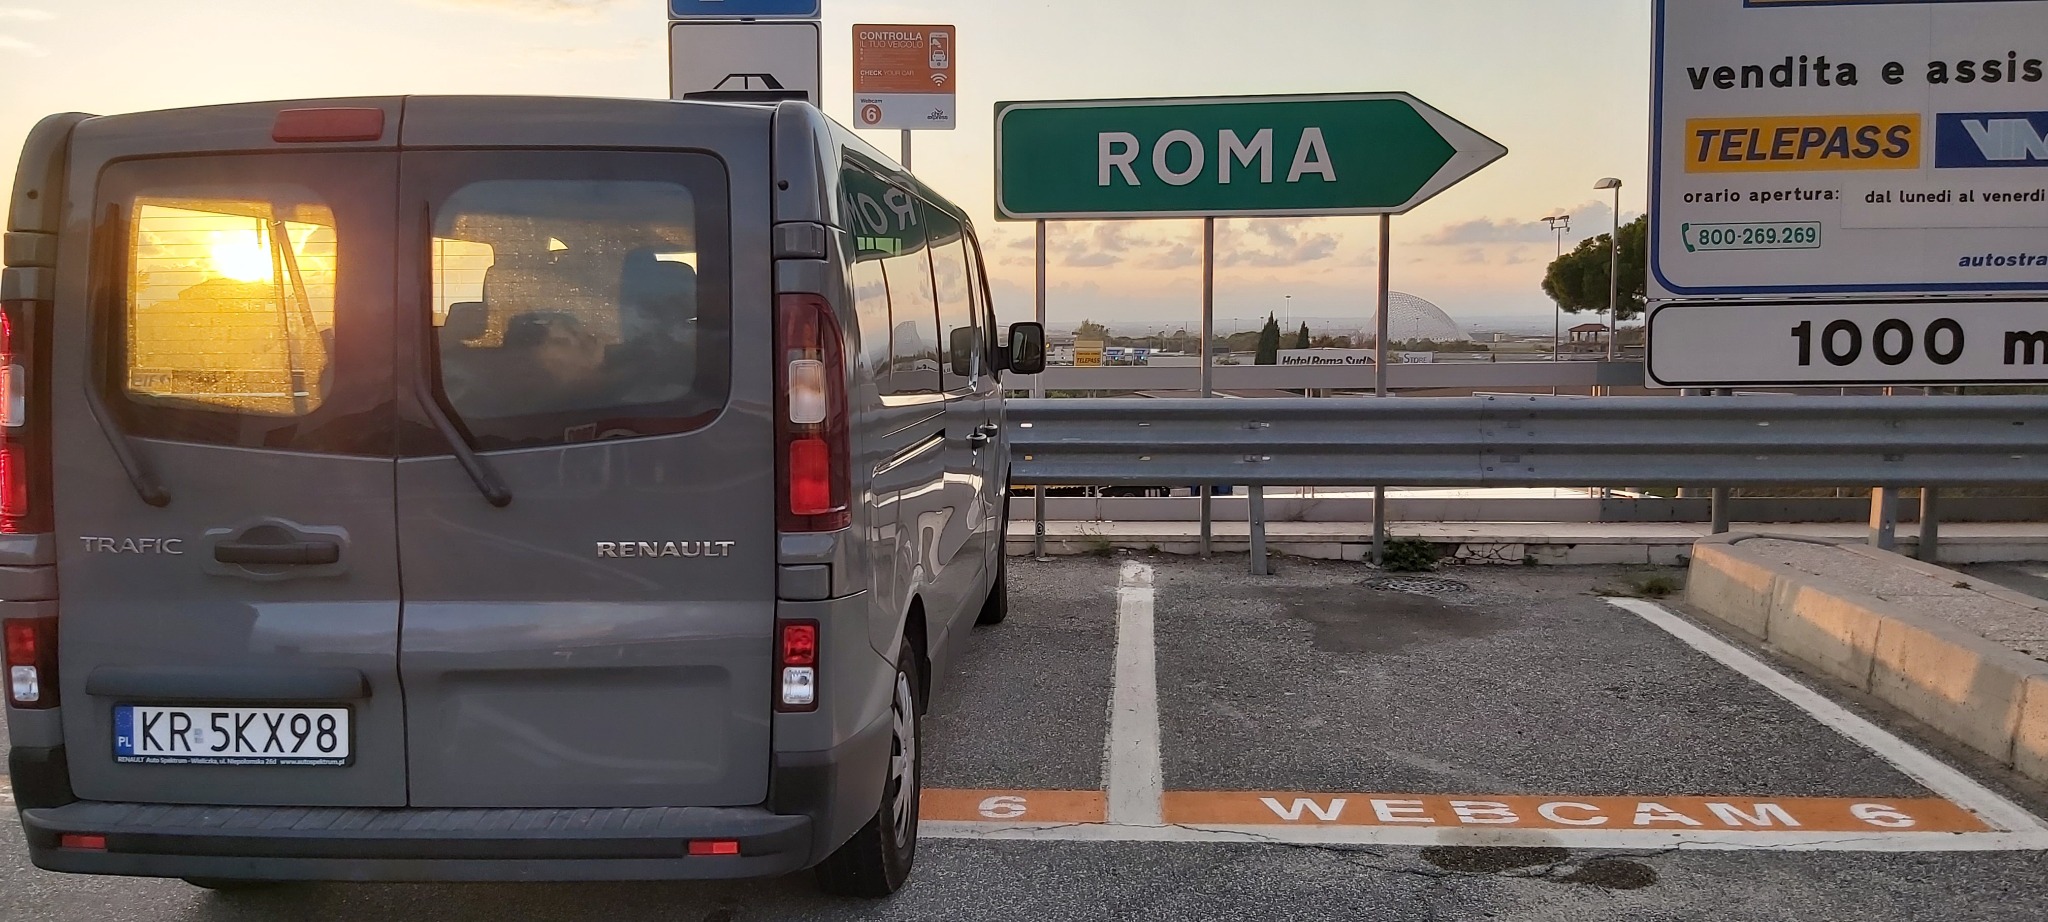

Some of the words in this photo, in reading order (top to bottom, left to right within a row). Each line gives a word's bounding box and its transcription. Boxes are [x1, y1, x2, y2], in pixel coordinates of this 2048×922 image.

[859, 31, 923, 41] CONTROLLA
[859, 40, 867, 48] IL
[869, 40, 886, 48] TUO
[887, 40, 924, 48] VEICOLO
[1686, 54, 1858, 90] vendita
[1881, 60, 1905, 86] e
[1926, 50, 2044, 85] assis
[866, 107, 877, 122] 6
[1694, 124, 1912, 163] TELEPASS
[1960, 118, 2048, 161] VIA
[1098, 126, 1337, 186] ROMA
[1683, 188, 1741, 203] orario
[1749, 187, 1839, 204] apertura:
[1864, 190, 1892, 203] dal
[1899, 189, 1951, 203] lunedi
[1958, 189, 1975, 203] al
[1982, 188, 2045, 203] venerdi
[1698, 227, 1817, 246] 800-269.269
[1958, 252, 2048, 267] autostra
[1790, 317, 1966, 367] 1000
[2003, 330, 2048, 365] m
[1282, 356, 1310, 365] Hotel
[1311, 356, 1343, 365] Roma
[1345, 356, 1367, 365] Sud
[79, 536, 184, 555] TRAFIC
[596, 541, 736, 558] RENAULT
[118, 736, 132, 748] PL
[141, 711, 192, 752] KR
[210, 712, 337, 754] 5KX98
[160, 757, 188, 765] Spektrum
[279, 758, 345, 766] www.autospektrum.pl
[978, 795, 1027, 818] 6
[1258, 797, 1803, 828] WEBCAM
[1849, 803, 1917, 829] 6
